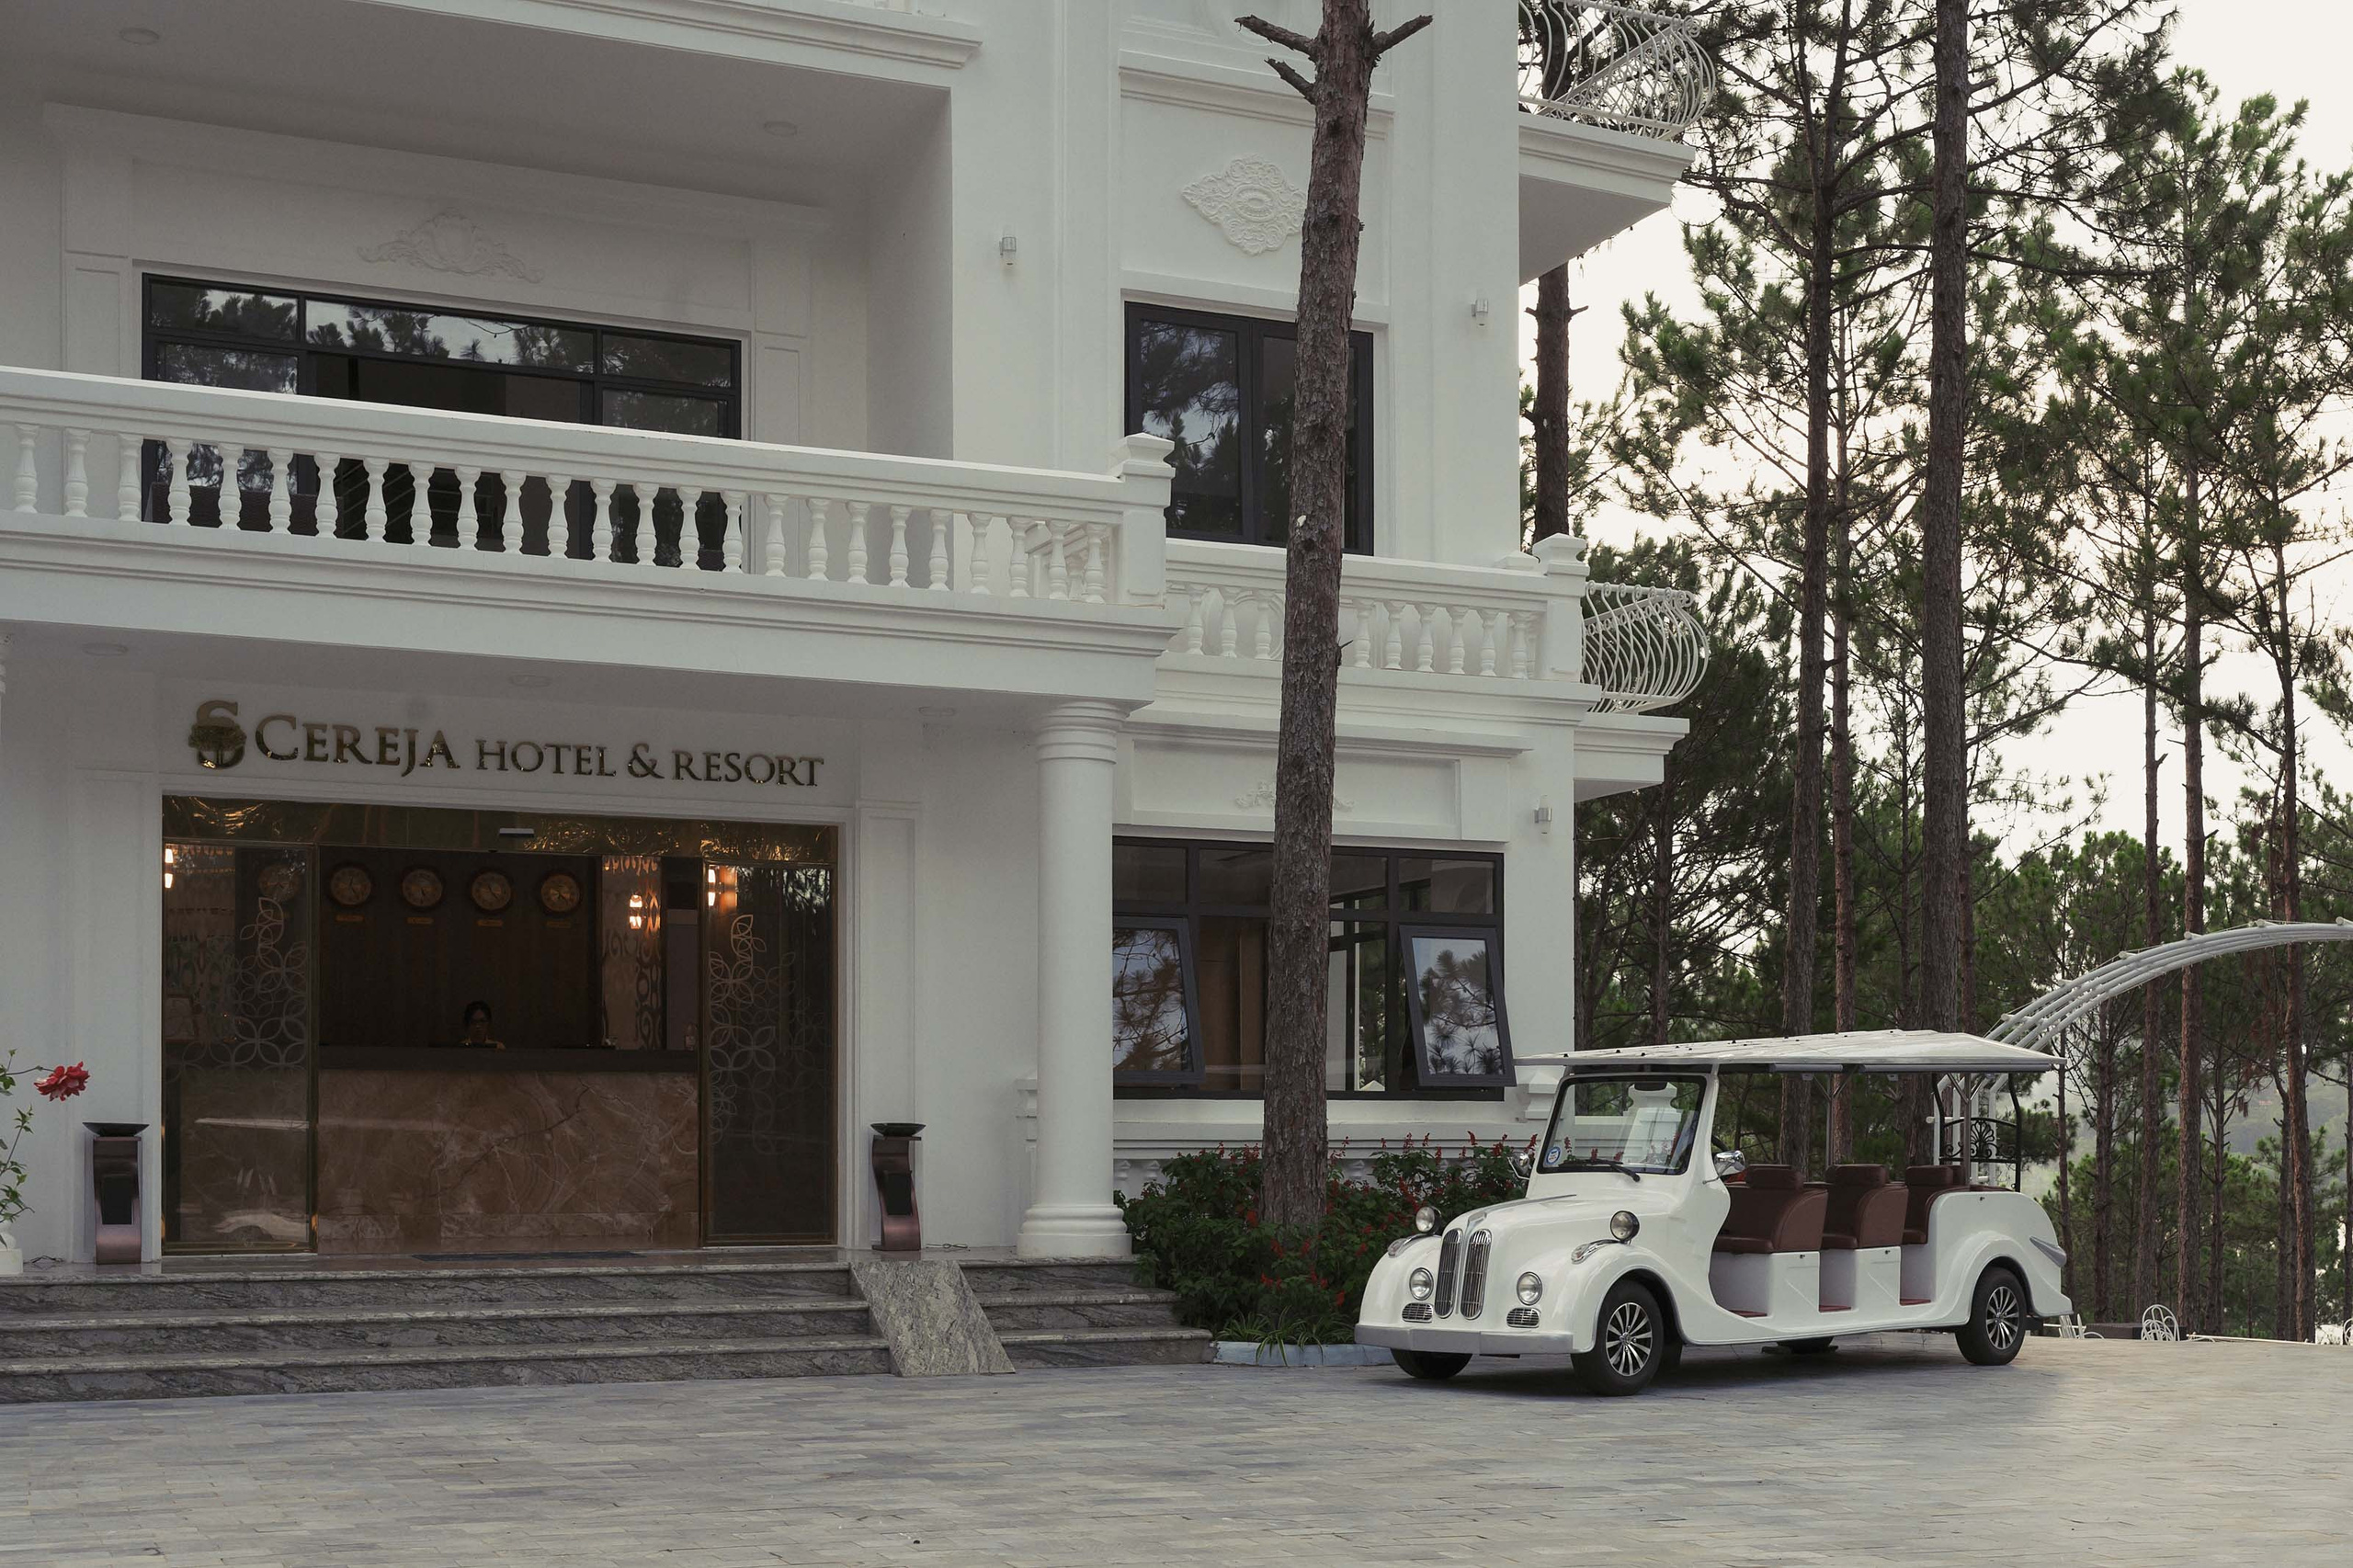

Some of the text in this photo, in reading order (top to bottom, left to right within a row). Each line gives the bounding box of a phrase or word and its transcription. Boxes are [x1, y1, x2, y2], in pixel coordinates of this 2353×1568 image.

[255, 714, 824, 787] CEREJA HOTEL & RESORT
